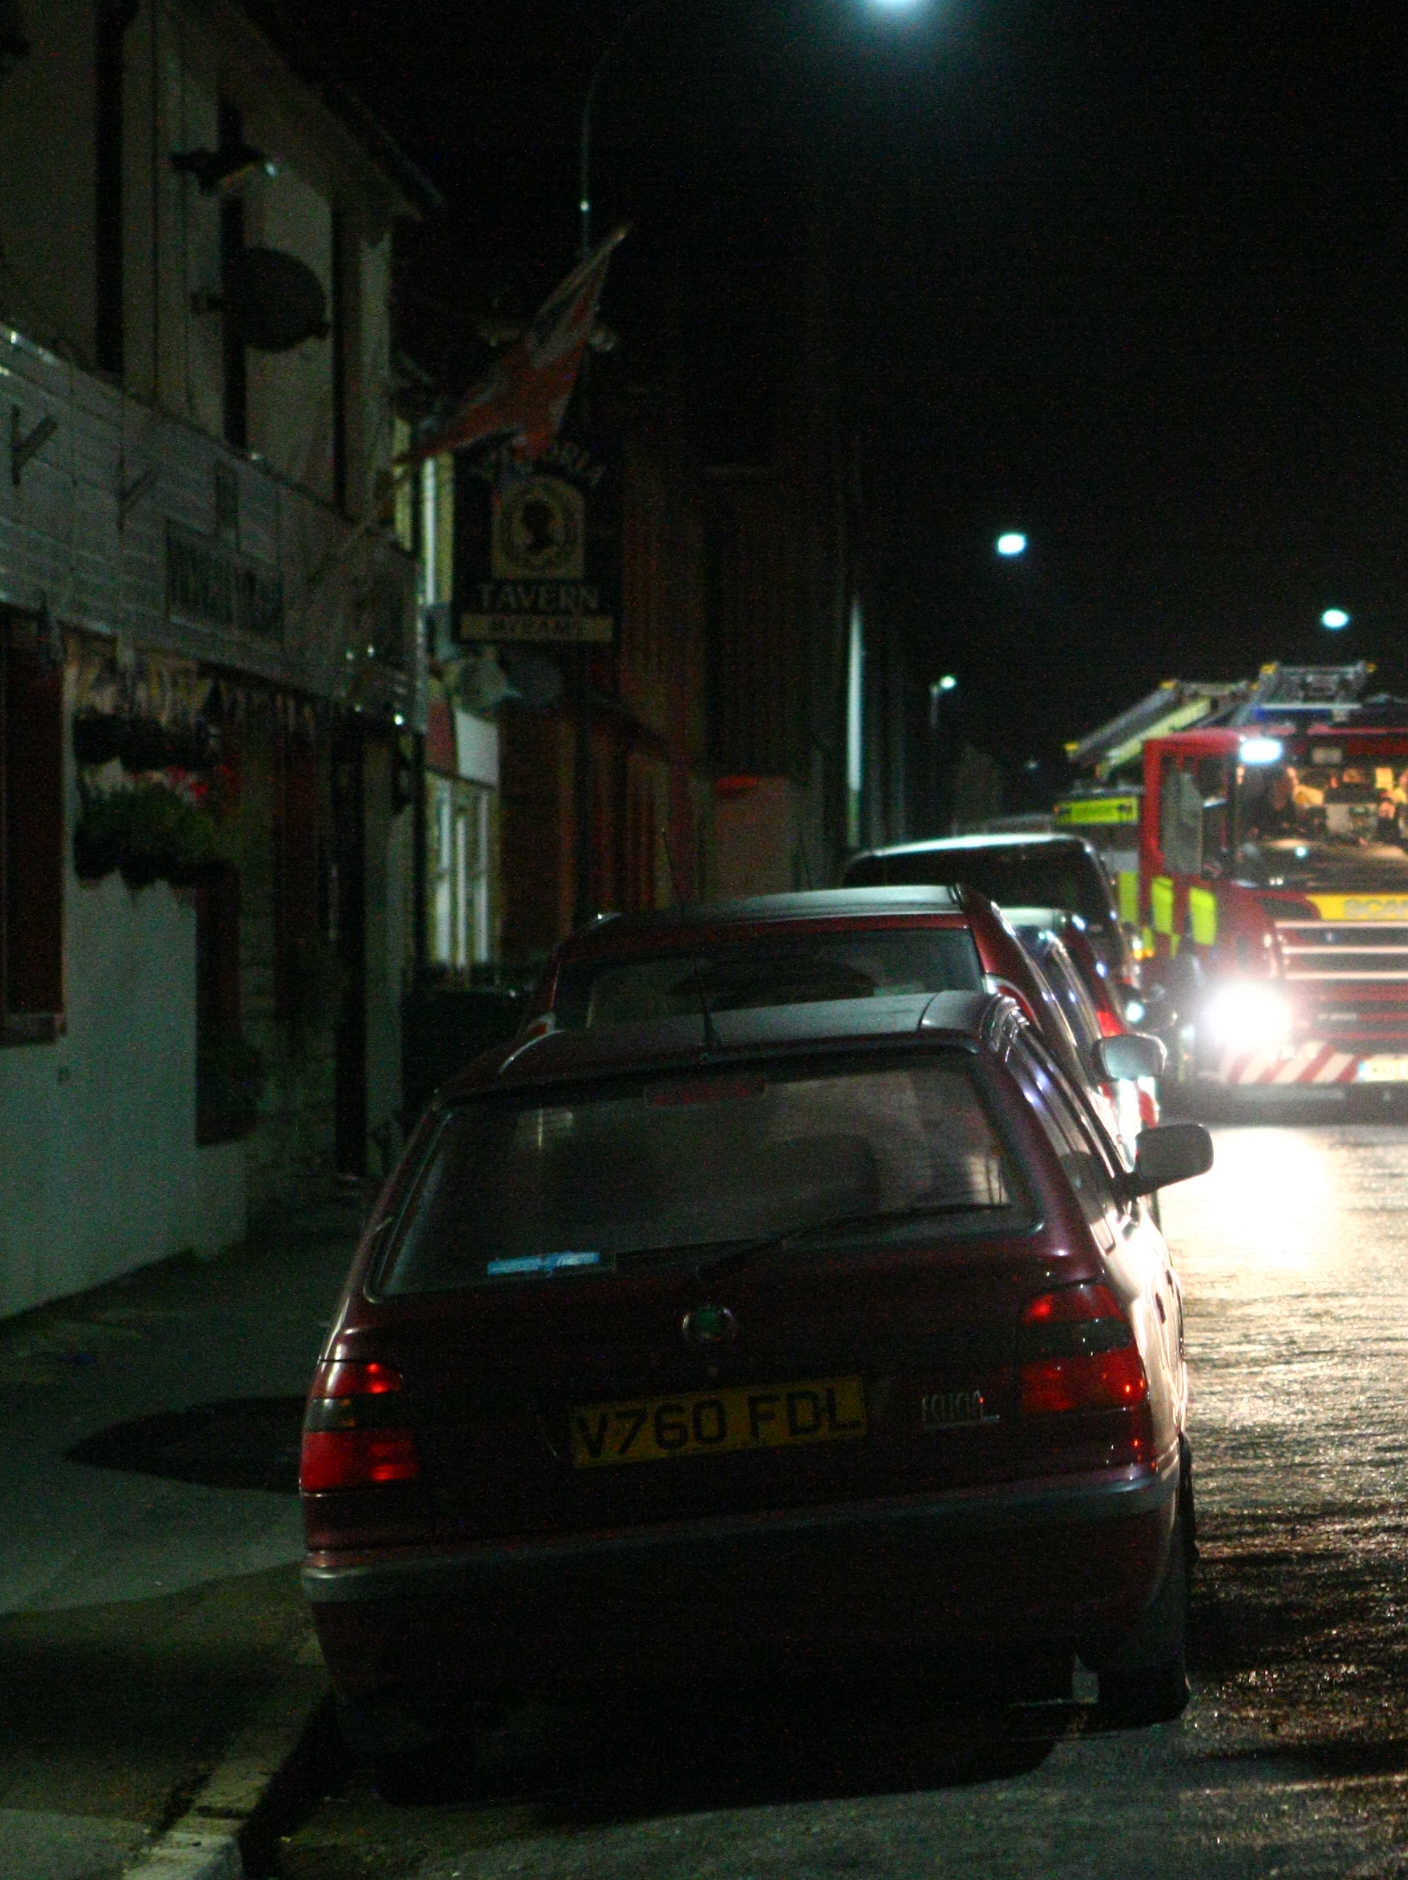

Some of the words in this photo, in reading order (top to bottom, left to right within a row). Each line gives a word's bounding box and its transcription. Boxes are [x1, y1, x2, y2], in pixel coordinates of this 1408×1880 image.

[476, 583, 600, 613] TAVERN
[577, 1398, 726, 1458] V760
[748, 1388, 862, 1440] FDL
